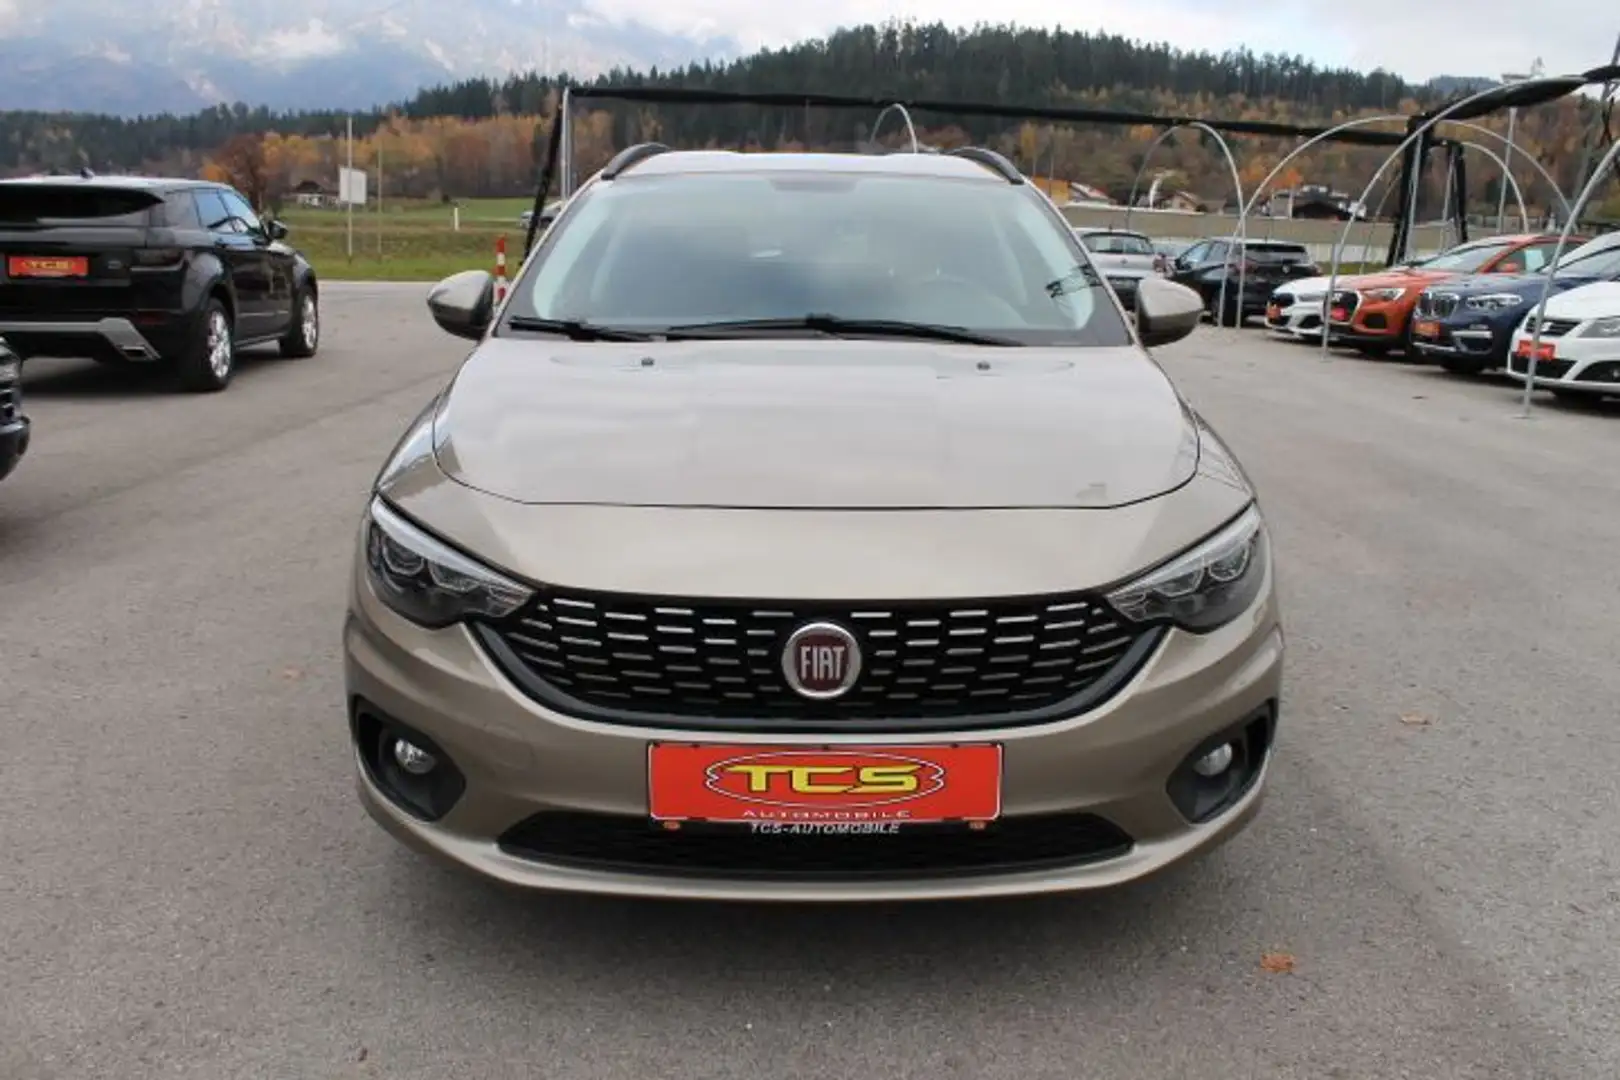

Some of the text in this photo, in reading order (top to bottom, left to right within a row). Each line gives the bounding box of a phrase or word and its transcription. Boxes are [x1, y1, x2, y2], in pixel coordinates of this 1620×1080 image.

[800, 645, 845, 680] FIAT
[726, 765, 921, 793] TCS
[741, 809, 910, 819] AUTOMOBILE
[750, 822, 900, 834] TCS-AUTOMOBILE
